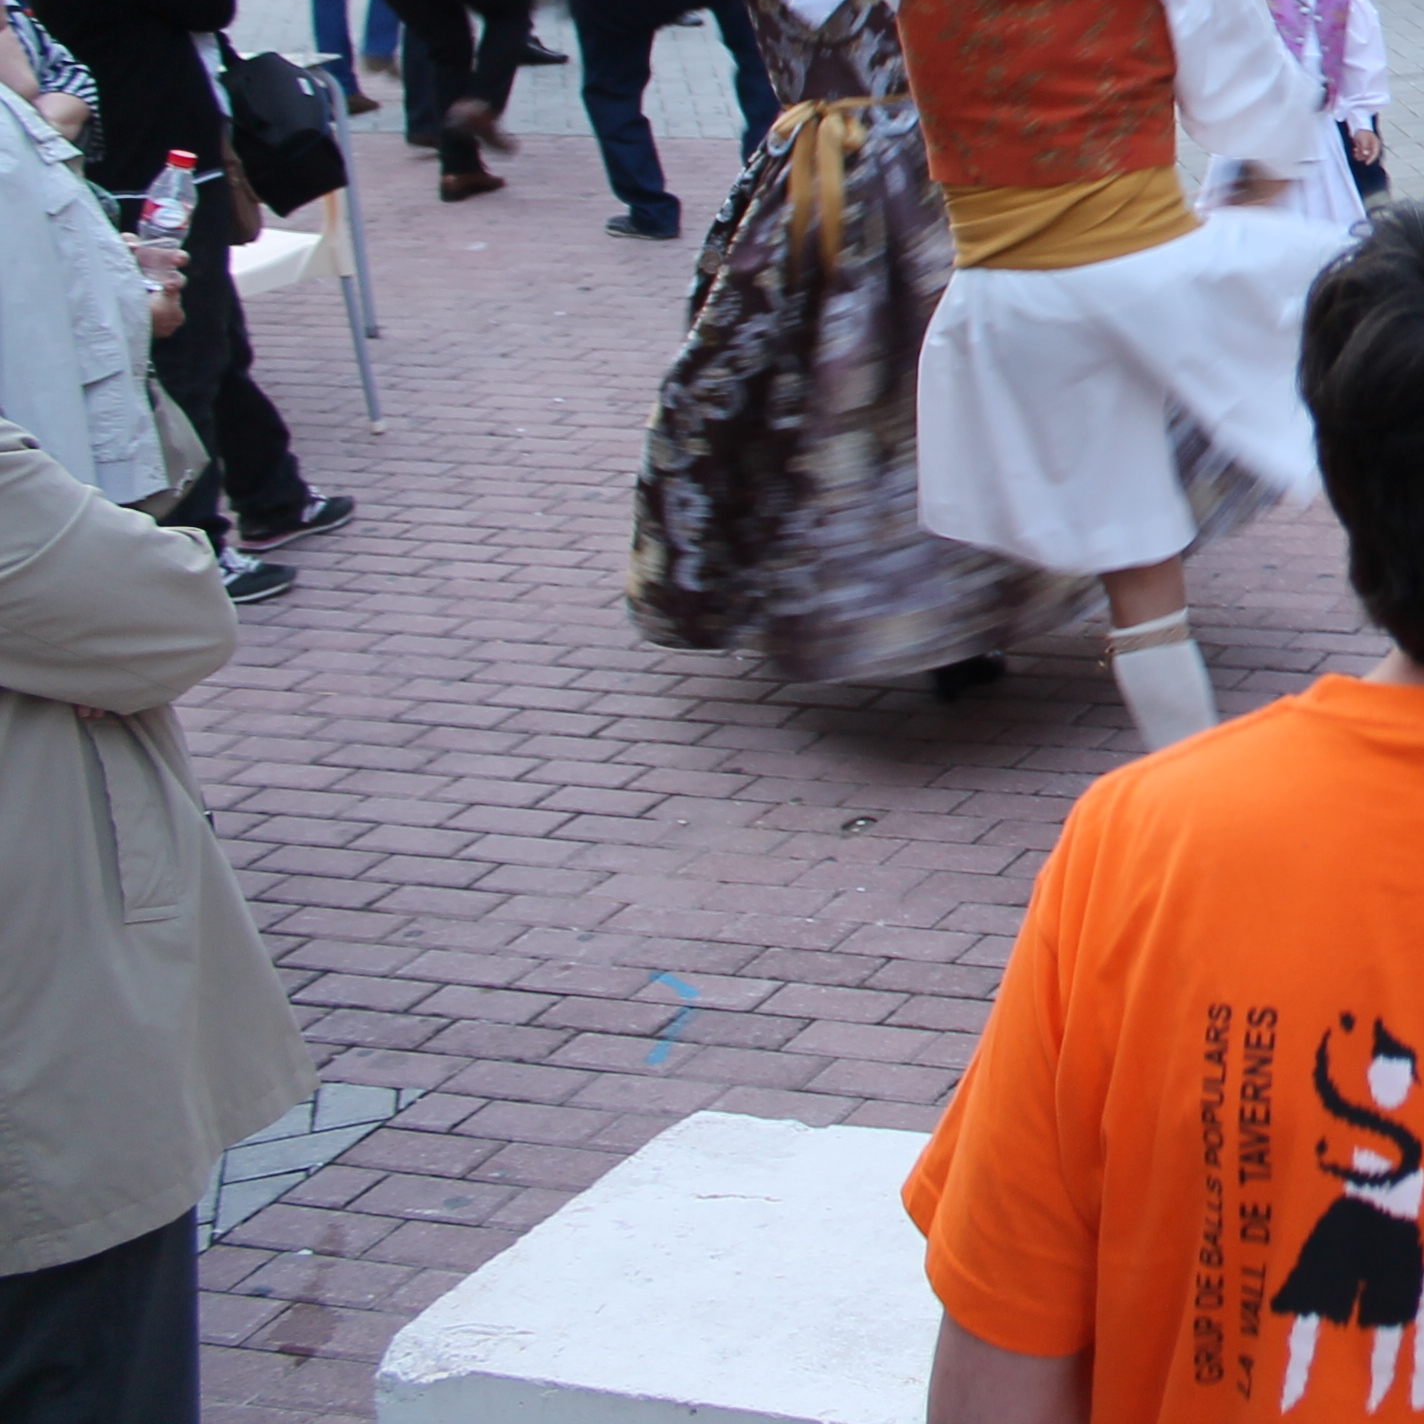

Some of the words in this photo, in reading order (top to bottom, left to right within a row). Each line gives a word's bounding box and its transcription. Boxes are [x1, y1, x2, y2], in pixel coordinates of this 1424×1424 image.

[1201, 1003, 1232, 1170] POPULARS
[1239, 1005, 1278, 1186] TAVERNES
[1200, 1174, 1224, 1268] BALLS
[1239, 1202, 1271, 1246] DE
[1195, 1273, 1224, 1310] DE
[1240, 1262, 1266, 1339] VALL
[1194, 1316, 1224, 1385] GRUP
[1237, 1353, 1254, 1400] LA
